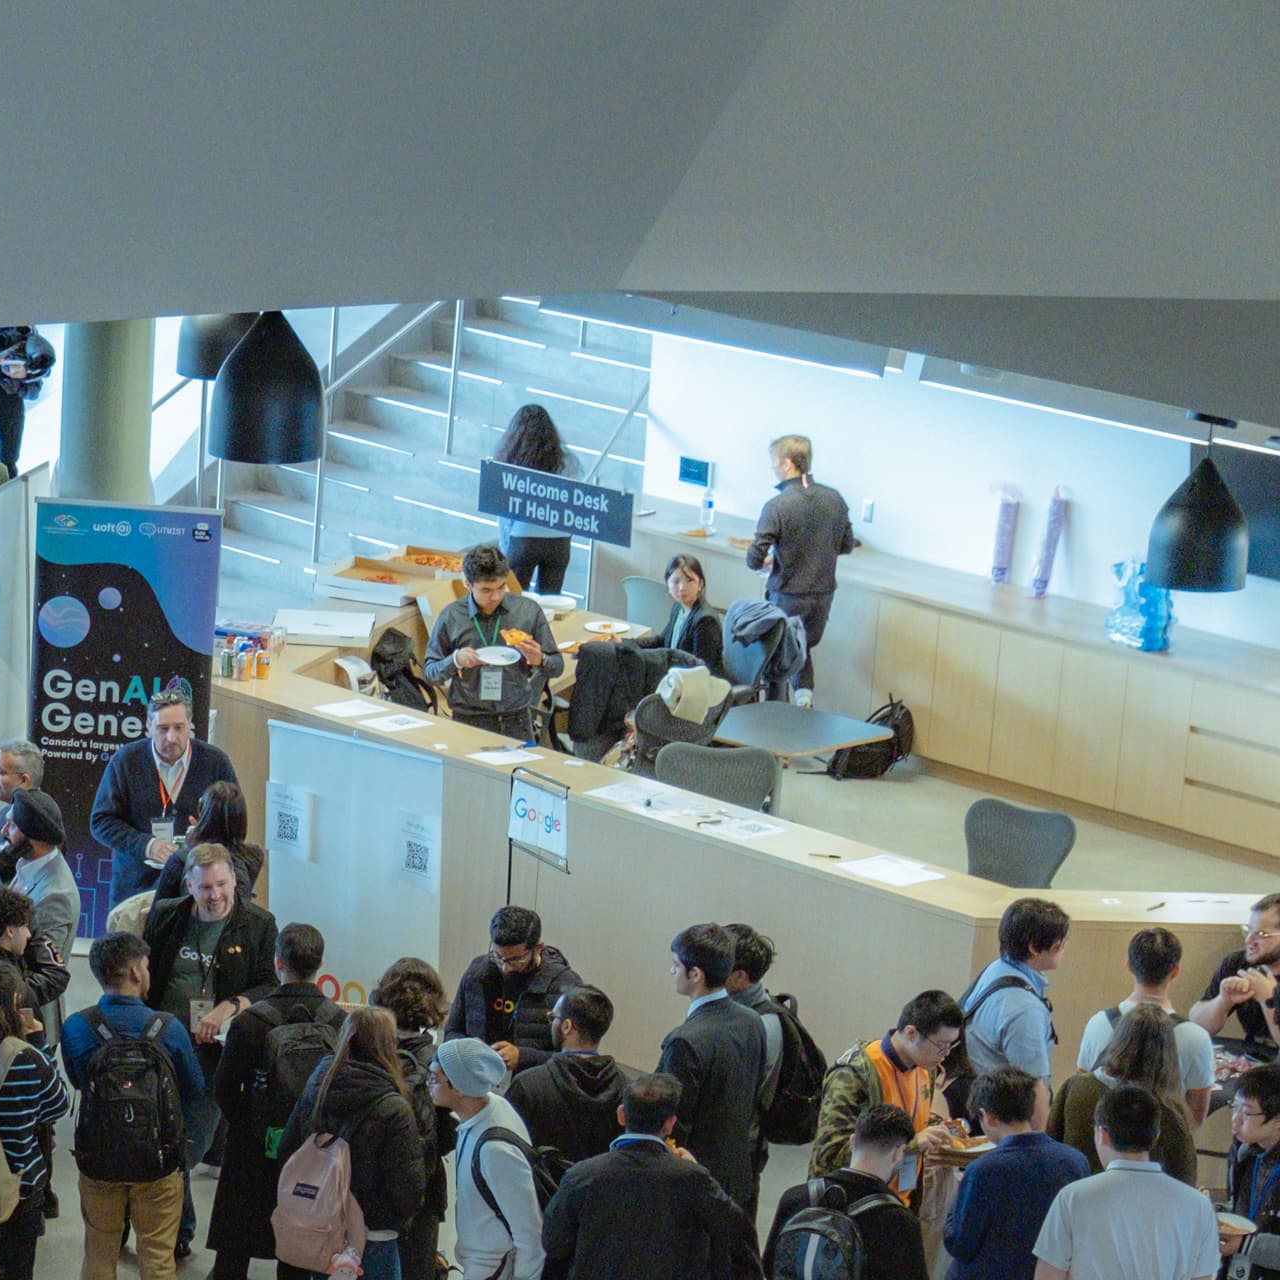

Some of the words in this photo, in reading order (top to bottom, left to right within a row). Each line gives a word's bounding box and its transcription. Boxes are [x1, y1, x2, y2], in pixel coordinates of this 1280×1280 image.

[502, 472, 569, 502] Welcome
[573, 488, 609, 512] Desk
[508, 496, 522, 514] IT
[526, 500, 559, 527] Help
[564, 509, 600, 534] Desk
[41, 702, 195, 738] Gene
[40, 736, 88, 749] Canada's
[41, 748, 83, 760] Powered
[85, 751, 98, 765] By
[514, 797, 561, 834] Google
[179, 946, 216, 968] Goog
